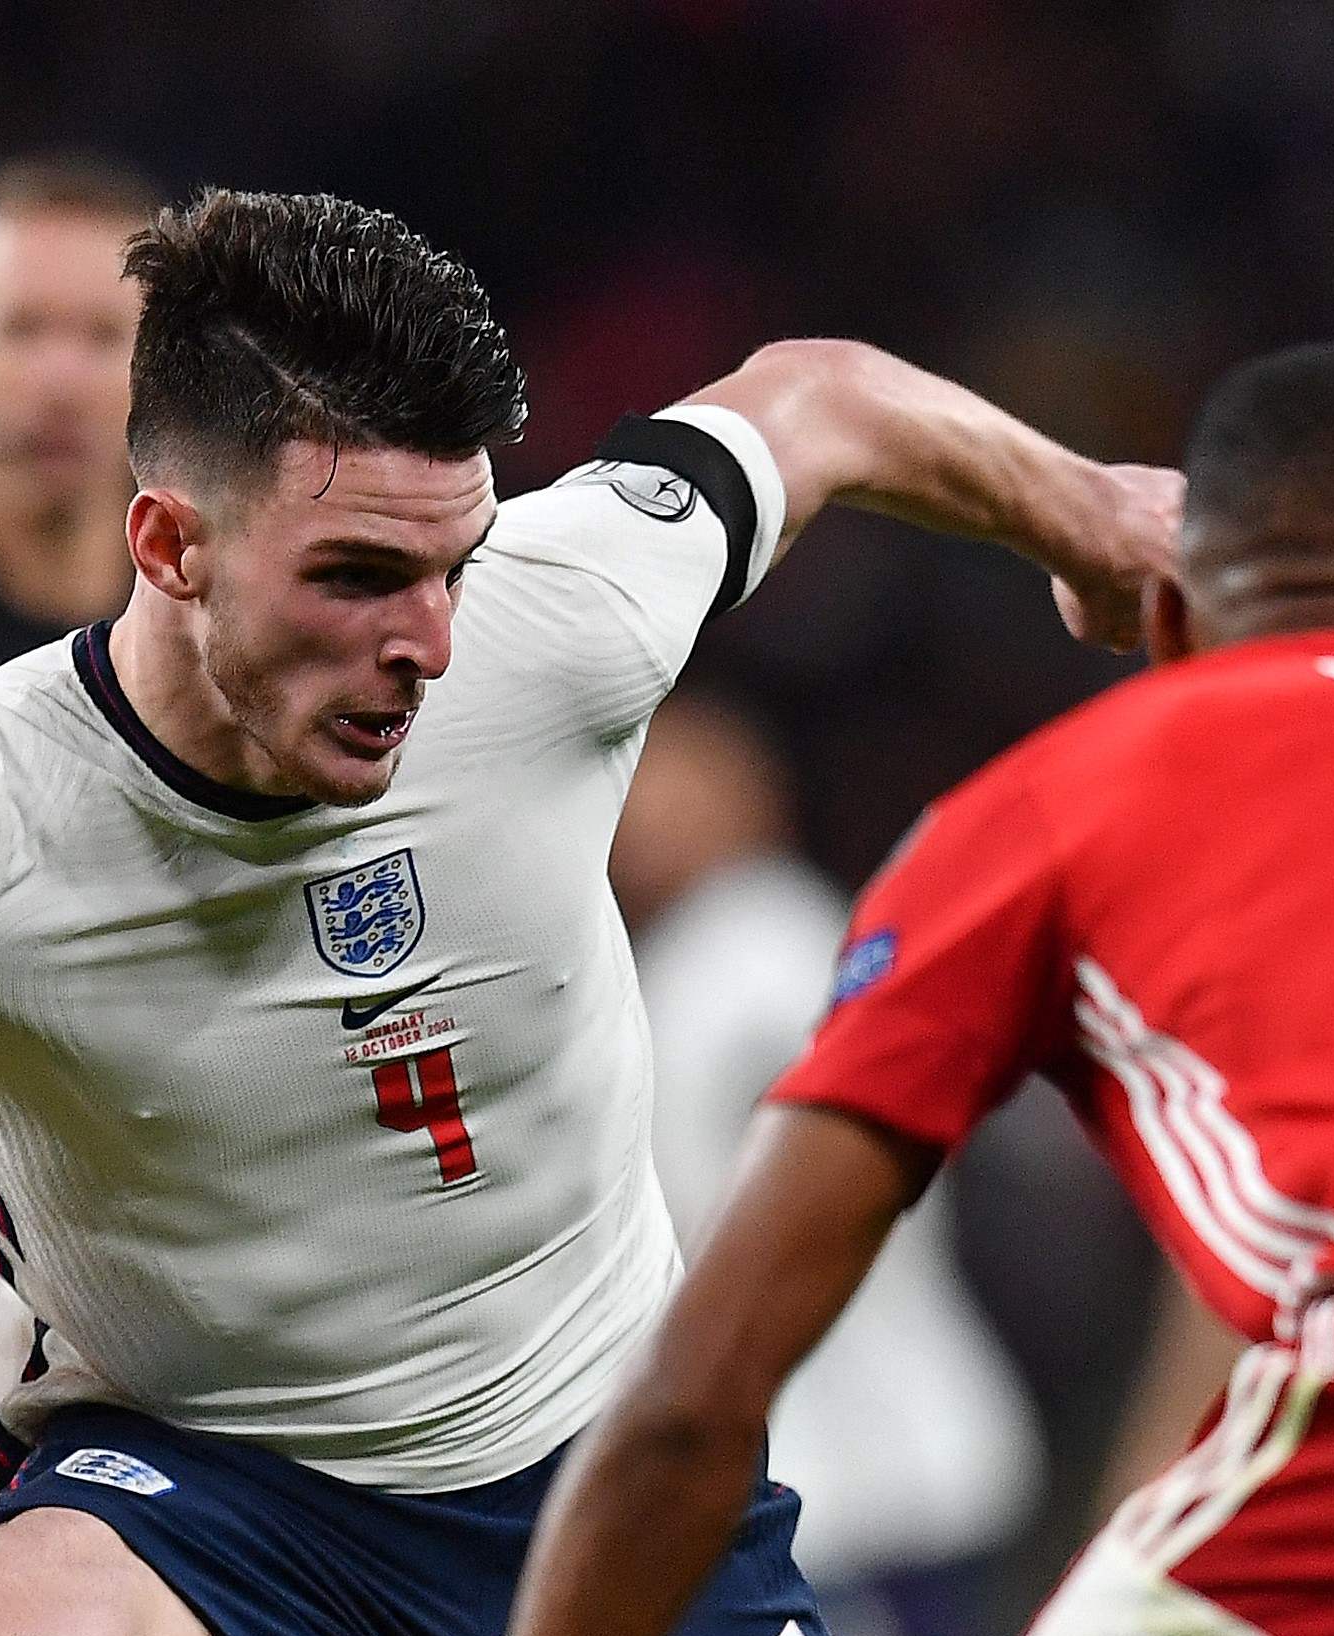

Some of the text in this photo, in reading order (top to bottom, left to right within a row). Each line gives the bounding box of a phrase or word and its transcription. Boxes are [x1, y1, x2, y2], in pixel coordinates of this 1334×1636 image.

[344, 1018, 455, 1061] 12 OCTOBER 2021
[365, 1012, 424, 1039] HUNGARY
[371, 1048, 476, 1184] 4
